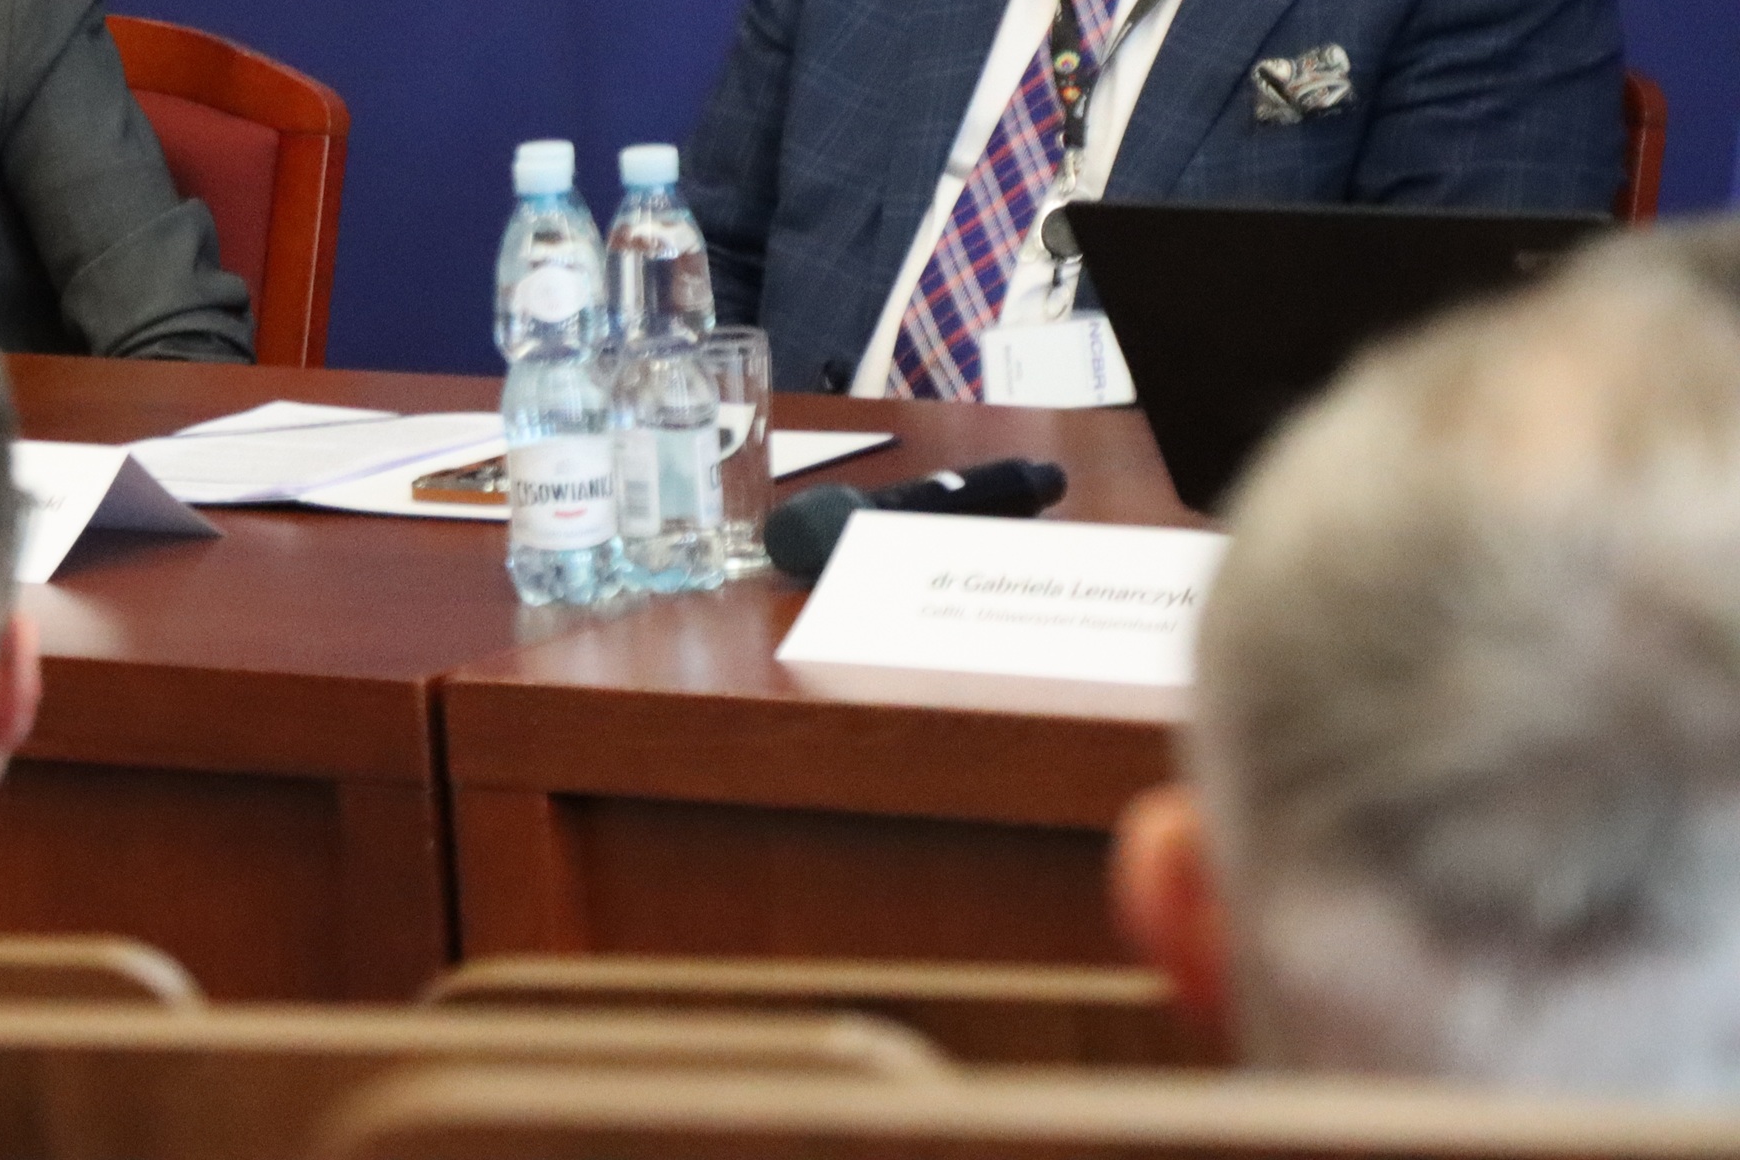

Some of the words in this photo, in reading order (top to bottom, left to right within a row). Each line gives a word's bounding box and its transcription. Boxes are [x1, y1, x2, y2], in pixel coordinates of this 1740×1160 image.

[930, 570, 957, 590] dr
[962, 572, 1064, 598] Gabriela
[1069, 578, 1197, 609] Lenarczyk
